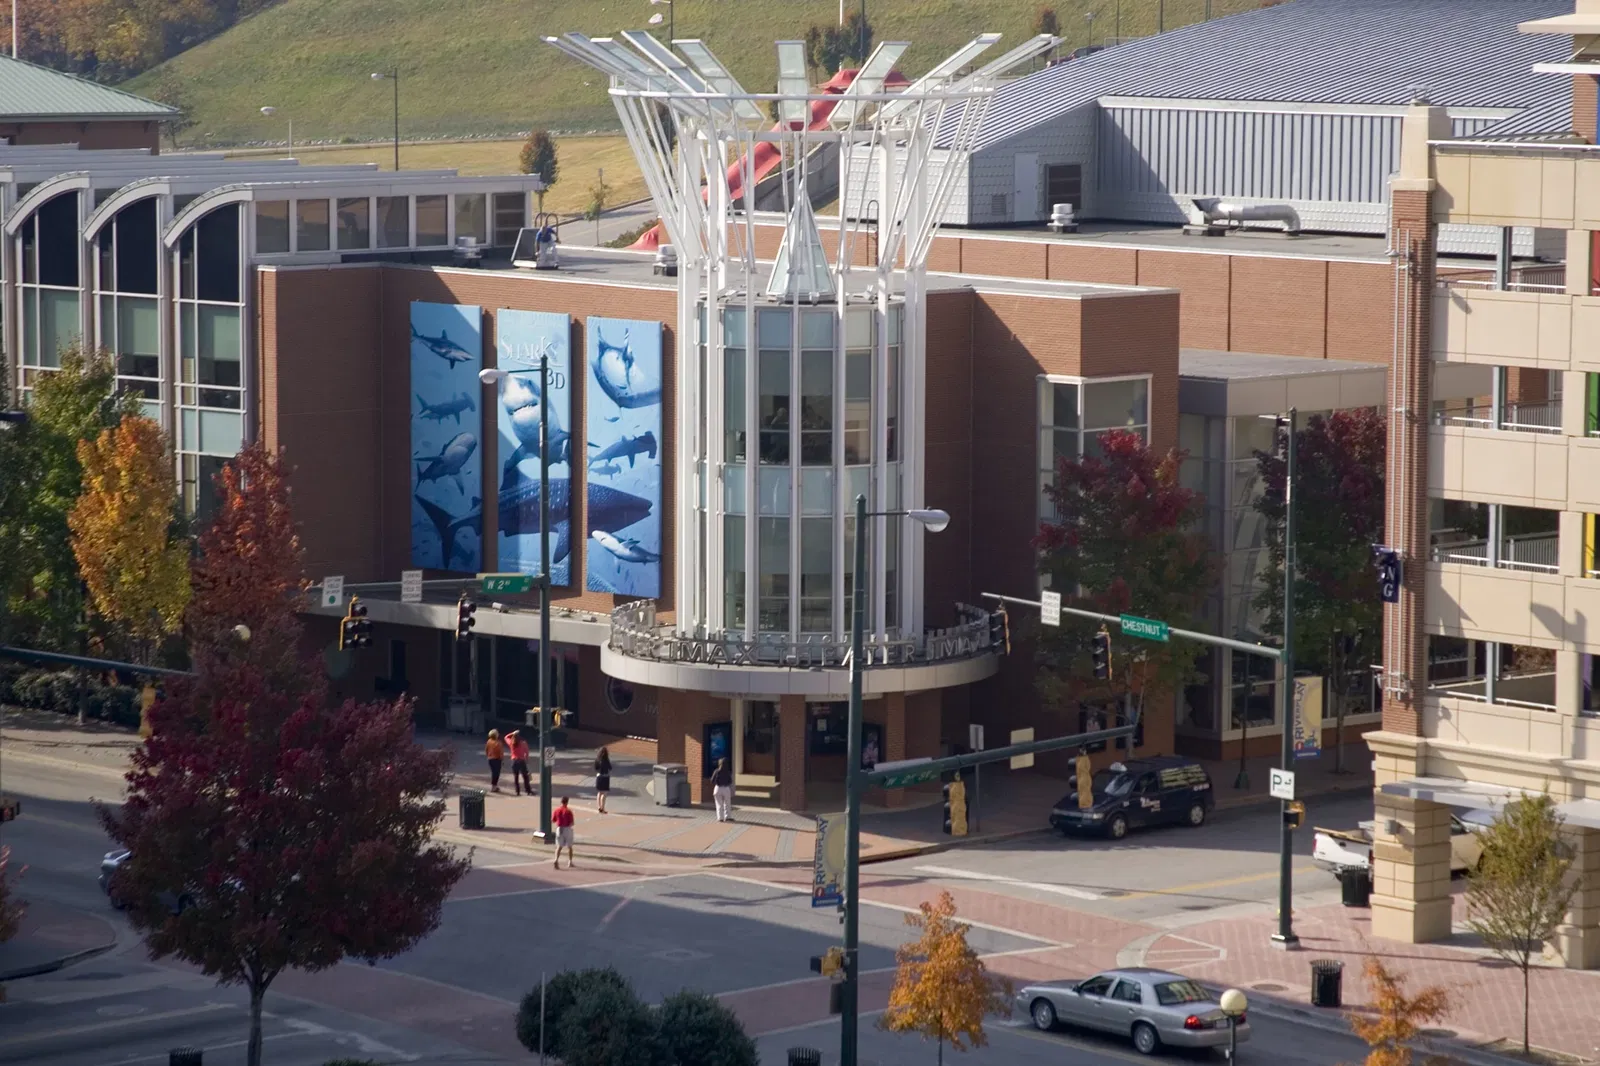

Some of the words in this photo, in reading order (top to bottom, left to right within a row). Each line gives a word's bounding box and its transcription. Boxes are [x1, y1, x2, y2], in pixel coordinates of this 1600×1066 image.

[486, 579, 496, 590] W
[1121, 618, 1161, 636] CHESTNUT
[667, 640, 758, 667] IMAX
